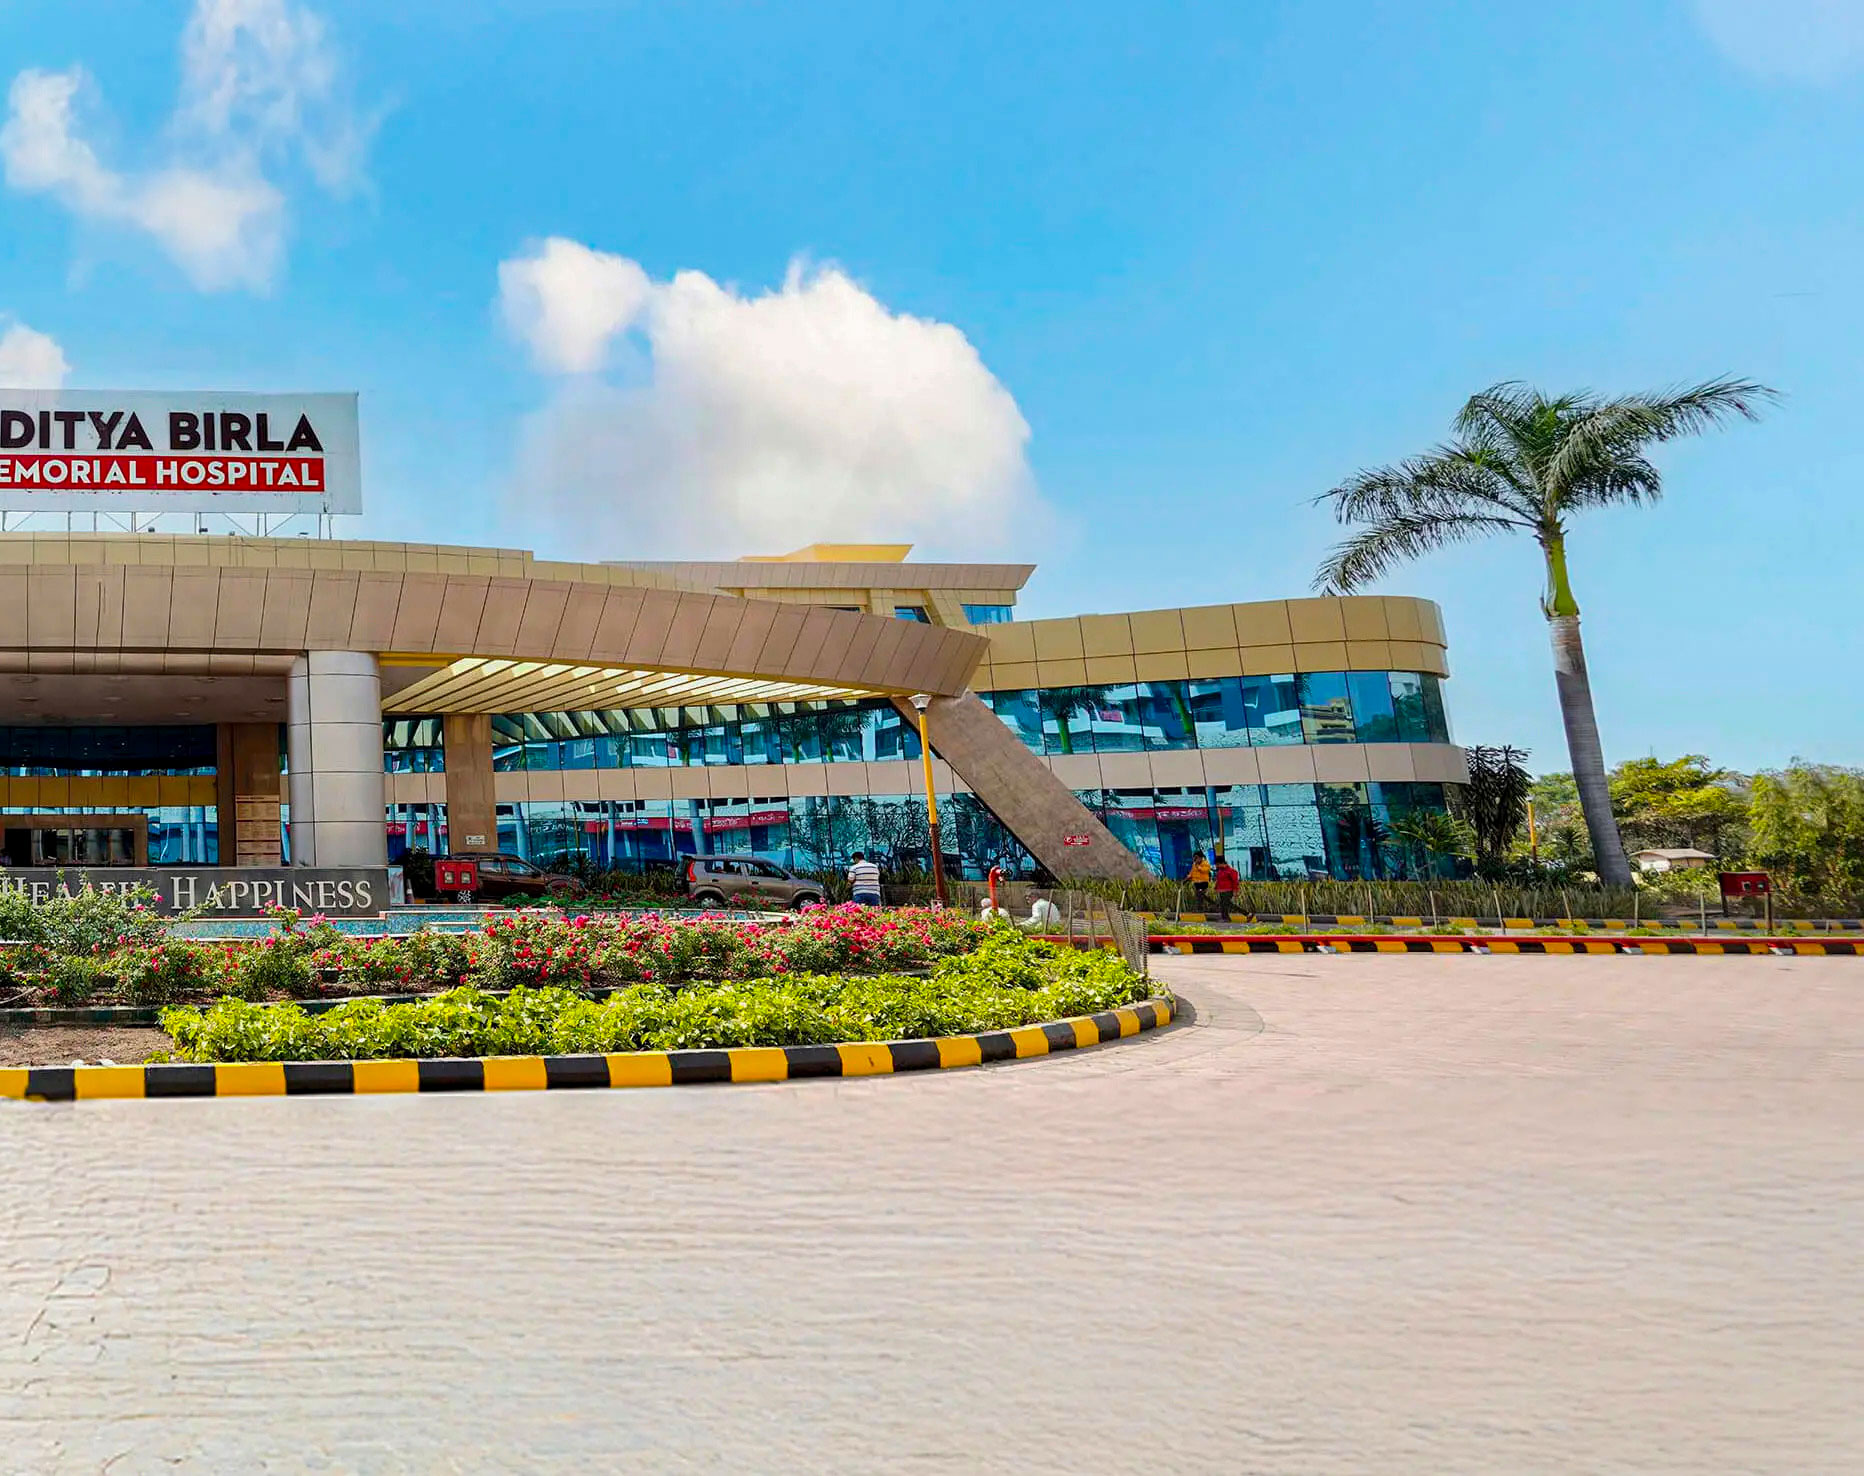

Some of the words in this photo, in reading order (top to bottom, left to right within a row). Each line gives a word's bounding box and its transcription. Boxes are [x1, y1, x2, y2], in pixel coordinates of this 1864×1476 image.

[169, 412, 324, 452] BIRLA
[156, 461, 319, 487] HOSPITAL
[170, 876, 372, 909] HAPPINESS
